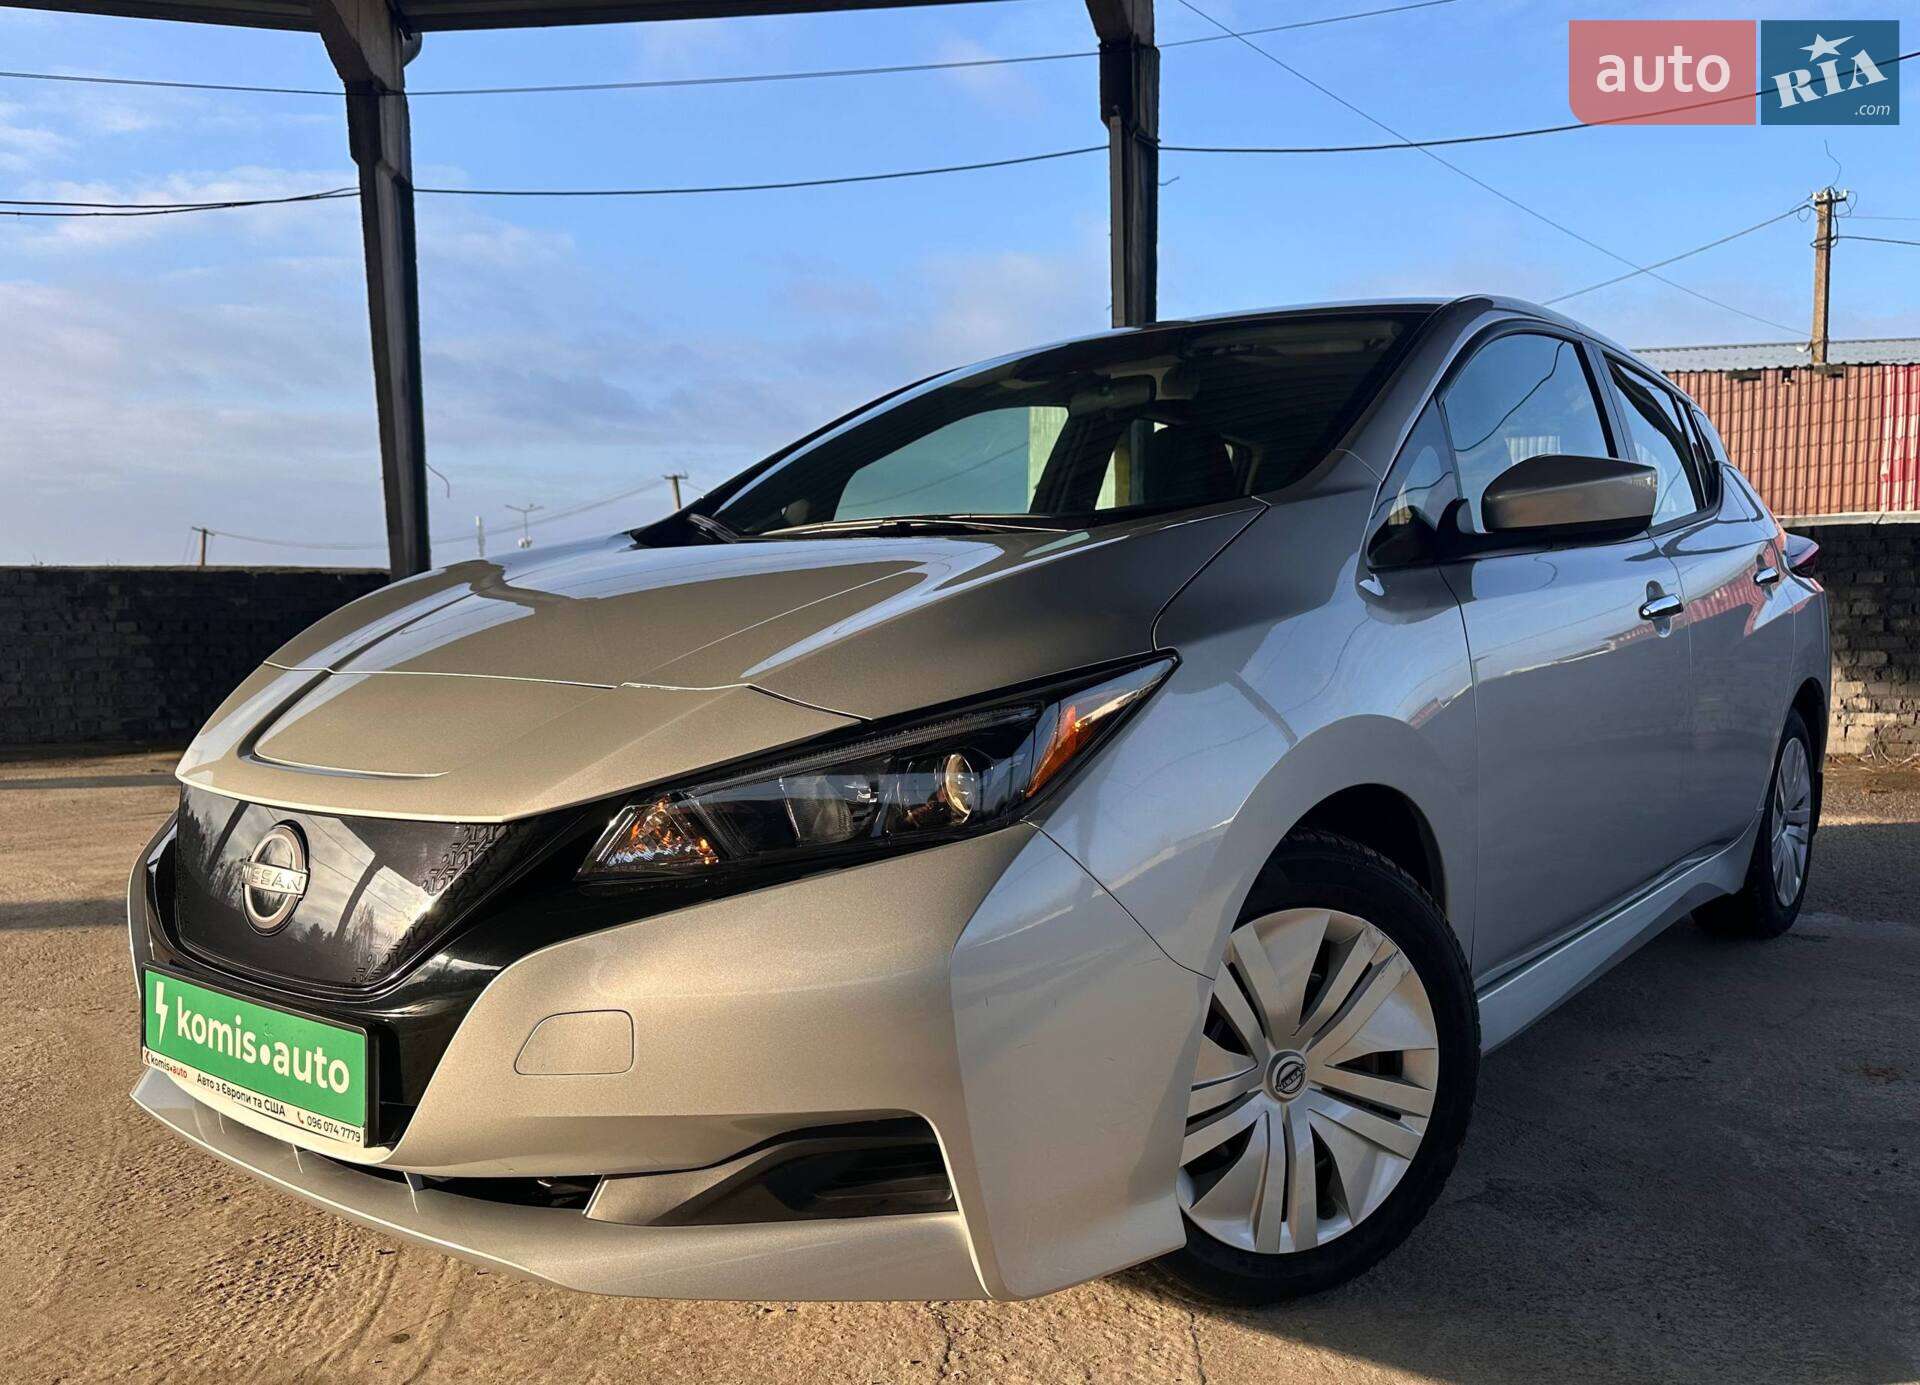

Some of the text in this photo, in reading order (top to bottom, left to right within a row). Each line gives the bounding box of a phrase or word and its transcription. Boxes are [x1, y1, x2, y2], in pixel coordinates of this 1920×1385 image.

[196, 1073, 215, 1089] Авто
[221, 1083, 252, 1104] Європи
[252, 1097, 262, 1108] та
[263, 1099, 286, 1116] США
[306, 1115, 361, 1142] 096 074 7779
